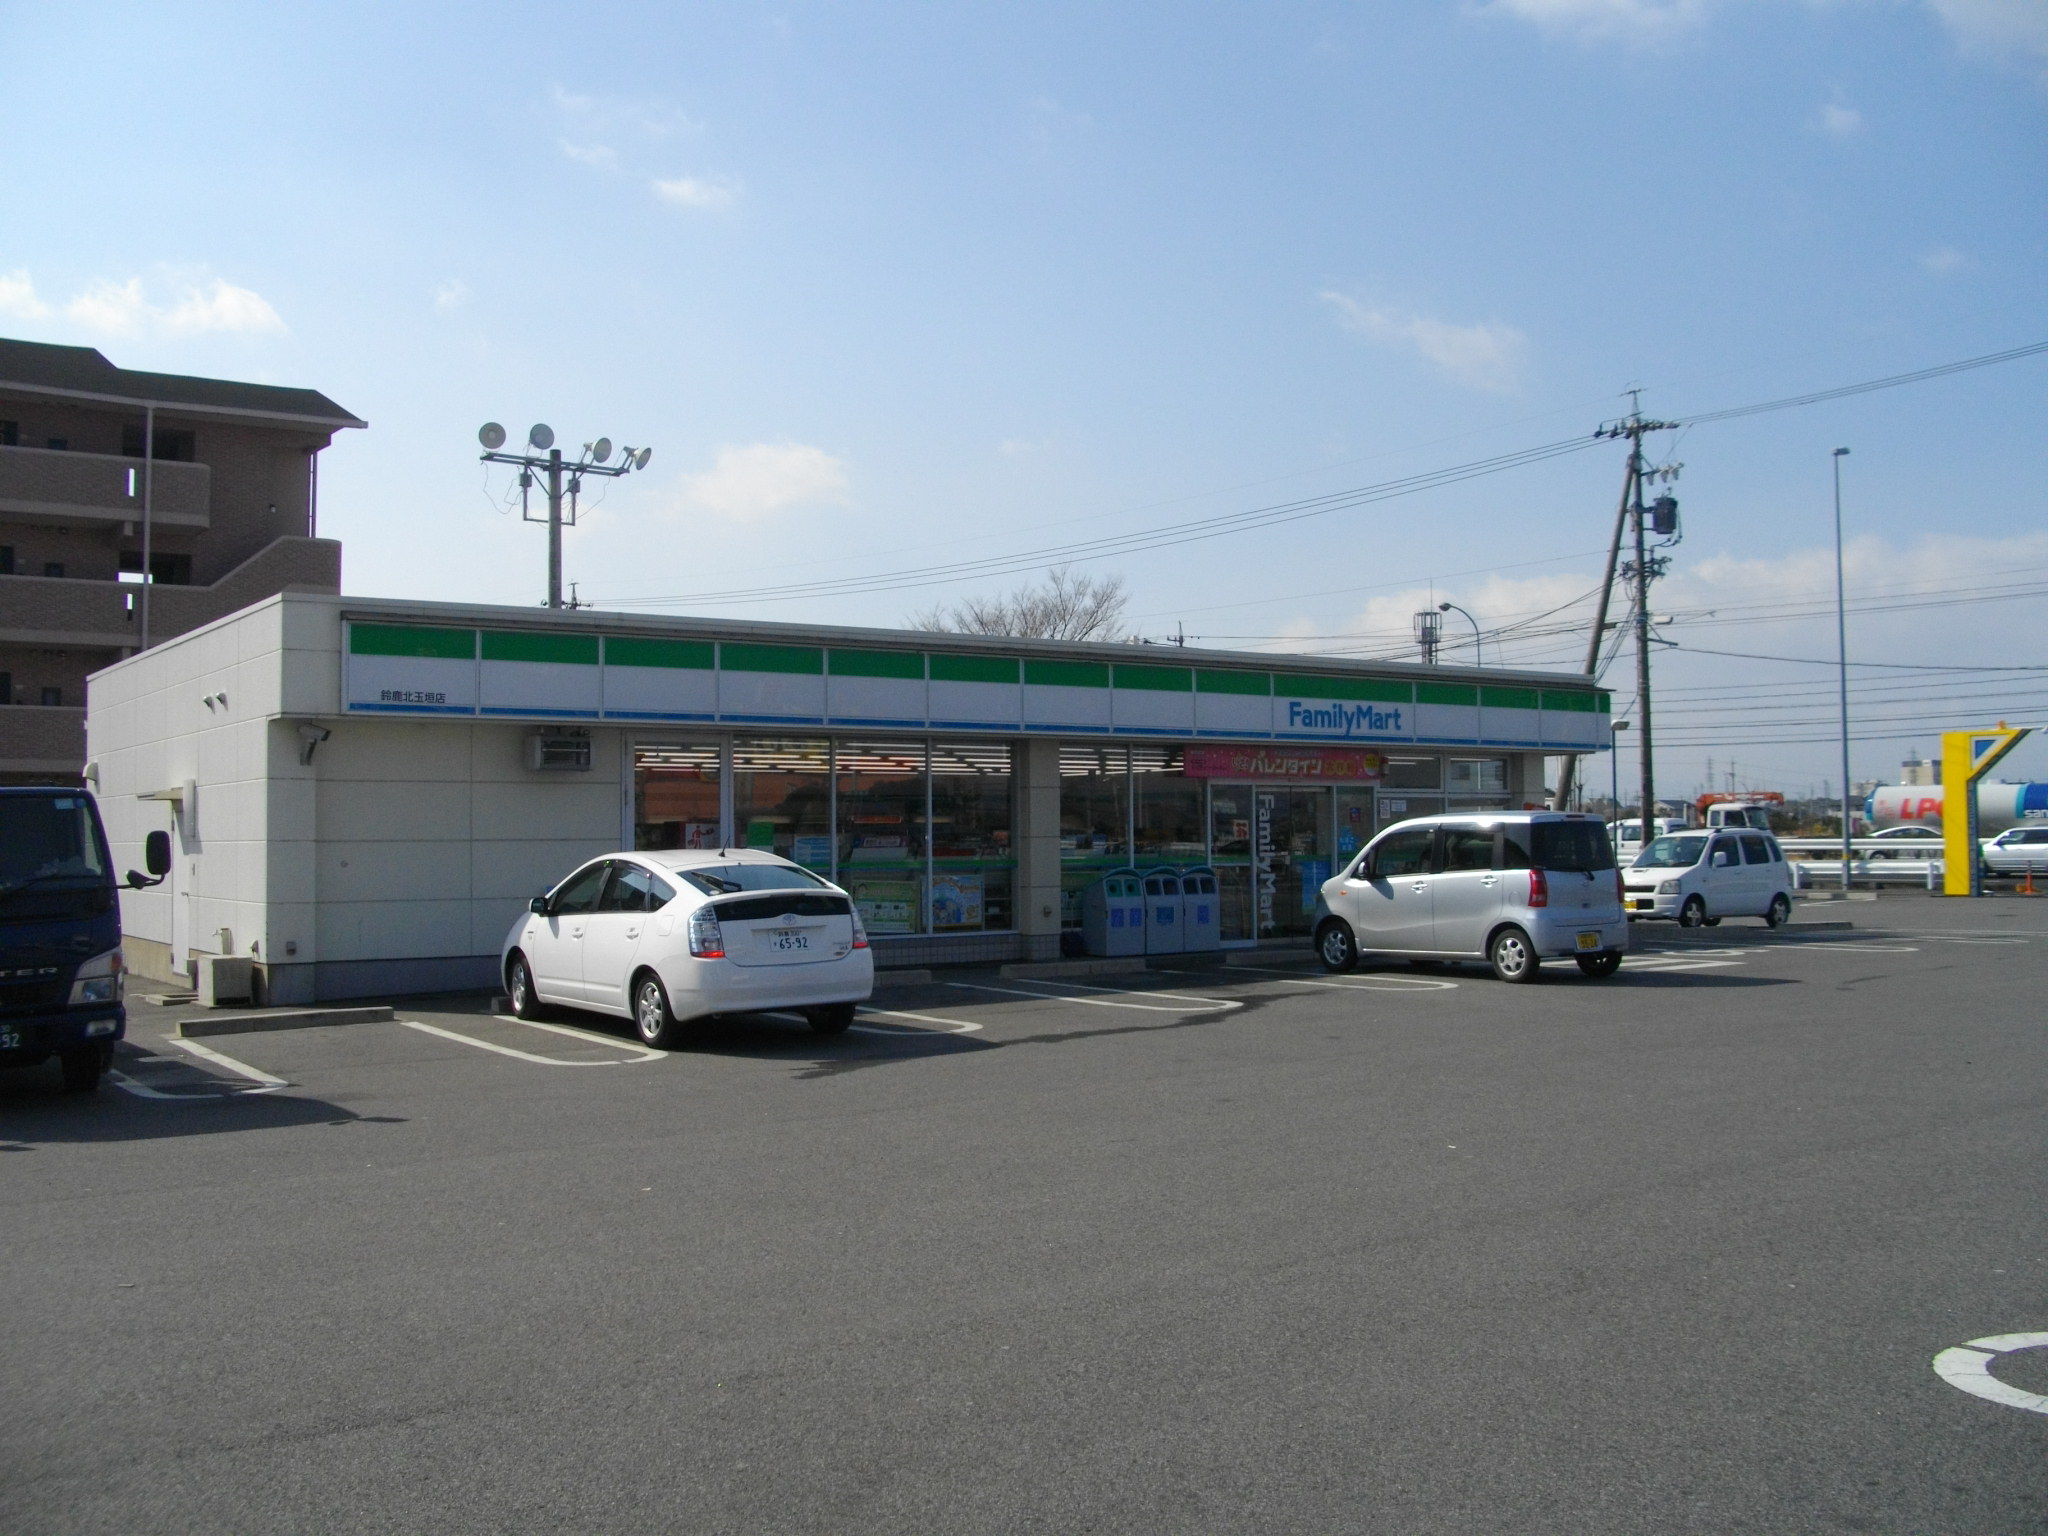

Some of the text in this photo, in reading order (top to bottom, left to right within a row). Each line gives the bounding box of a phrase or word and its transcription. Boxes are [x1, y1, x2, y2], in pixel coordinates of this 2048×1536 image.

[381, 689, 446, 704] 鈴鹿北玉垣店
[1289, 702, 1402, 737] FamilyMart
[1257, 794, 1277, 930] FamilyMart
